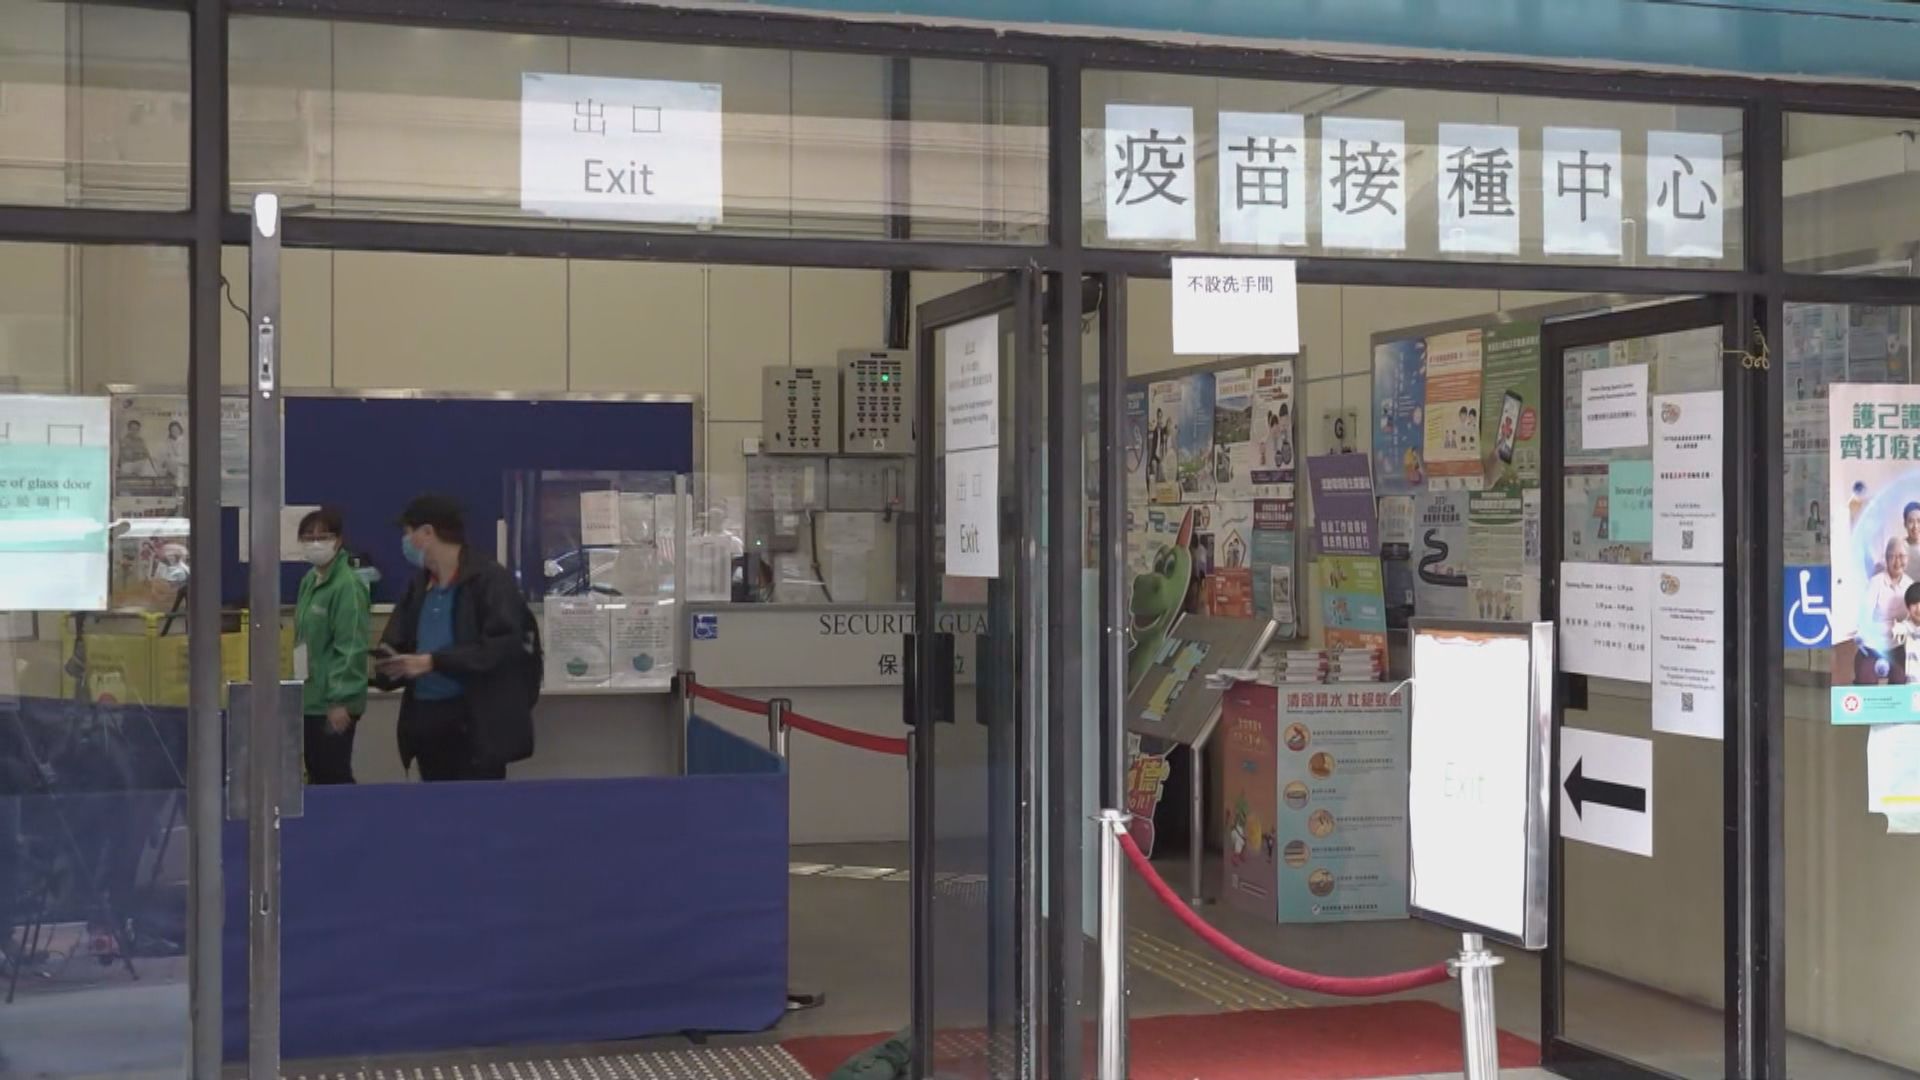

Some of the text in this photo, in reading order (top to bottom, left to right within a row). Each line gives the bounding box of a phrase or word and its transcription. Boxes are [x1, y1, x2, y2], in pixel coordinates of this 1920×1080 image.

[573, 98, 662, 136] 出口
[584, 158, 655, 195] Exit
[1114, 128, 1718, 222] 疫苗接種中心
[1188, 275, 1273, 293] 不設洗手間
[10, 477, 24, 488] of
[28, 478, 59, 491] glass
[62, 478, 91, 489] door
[960, 522, 980, 554] Exit
